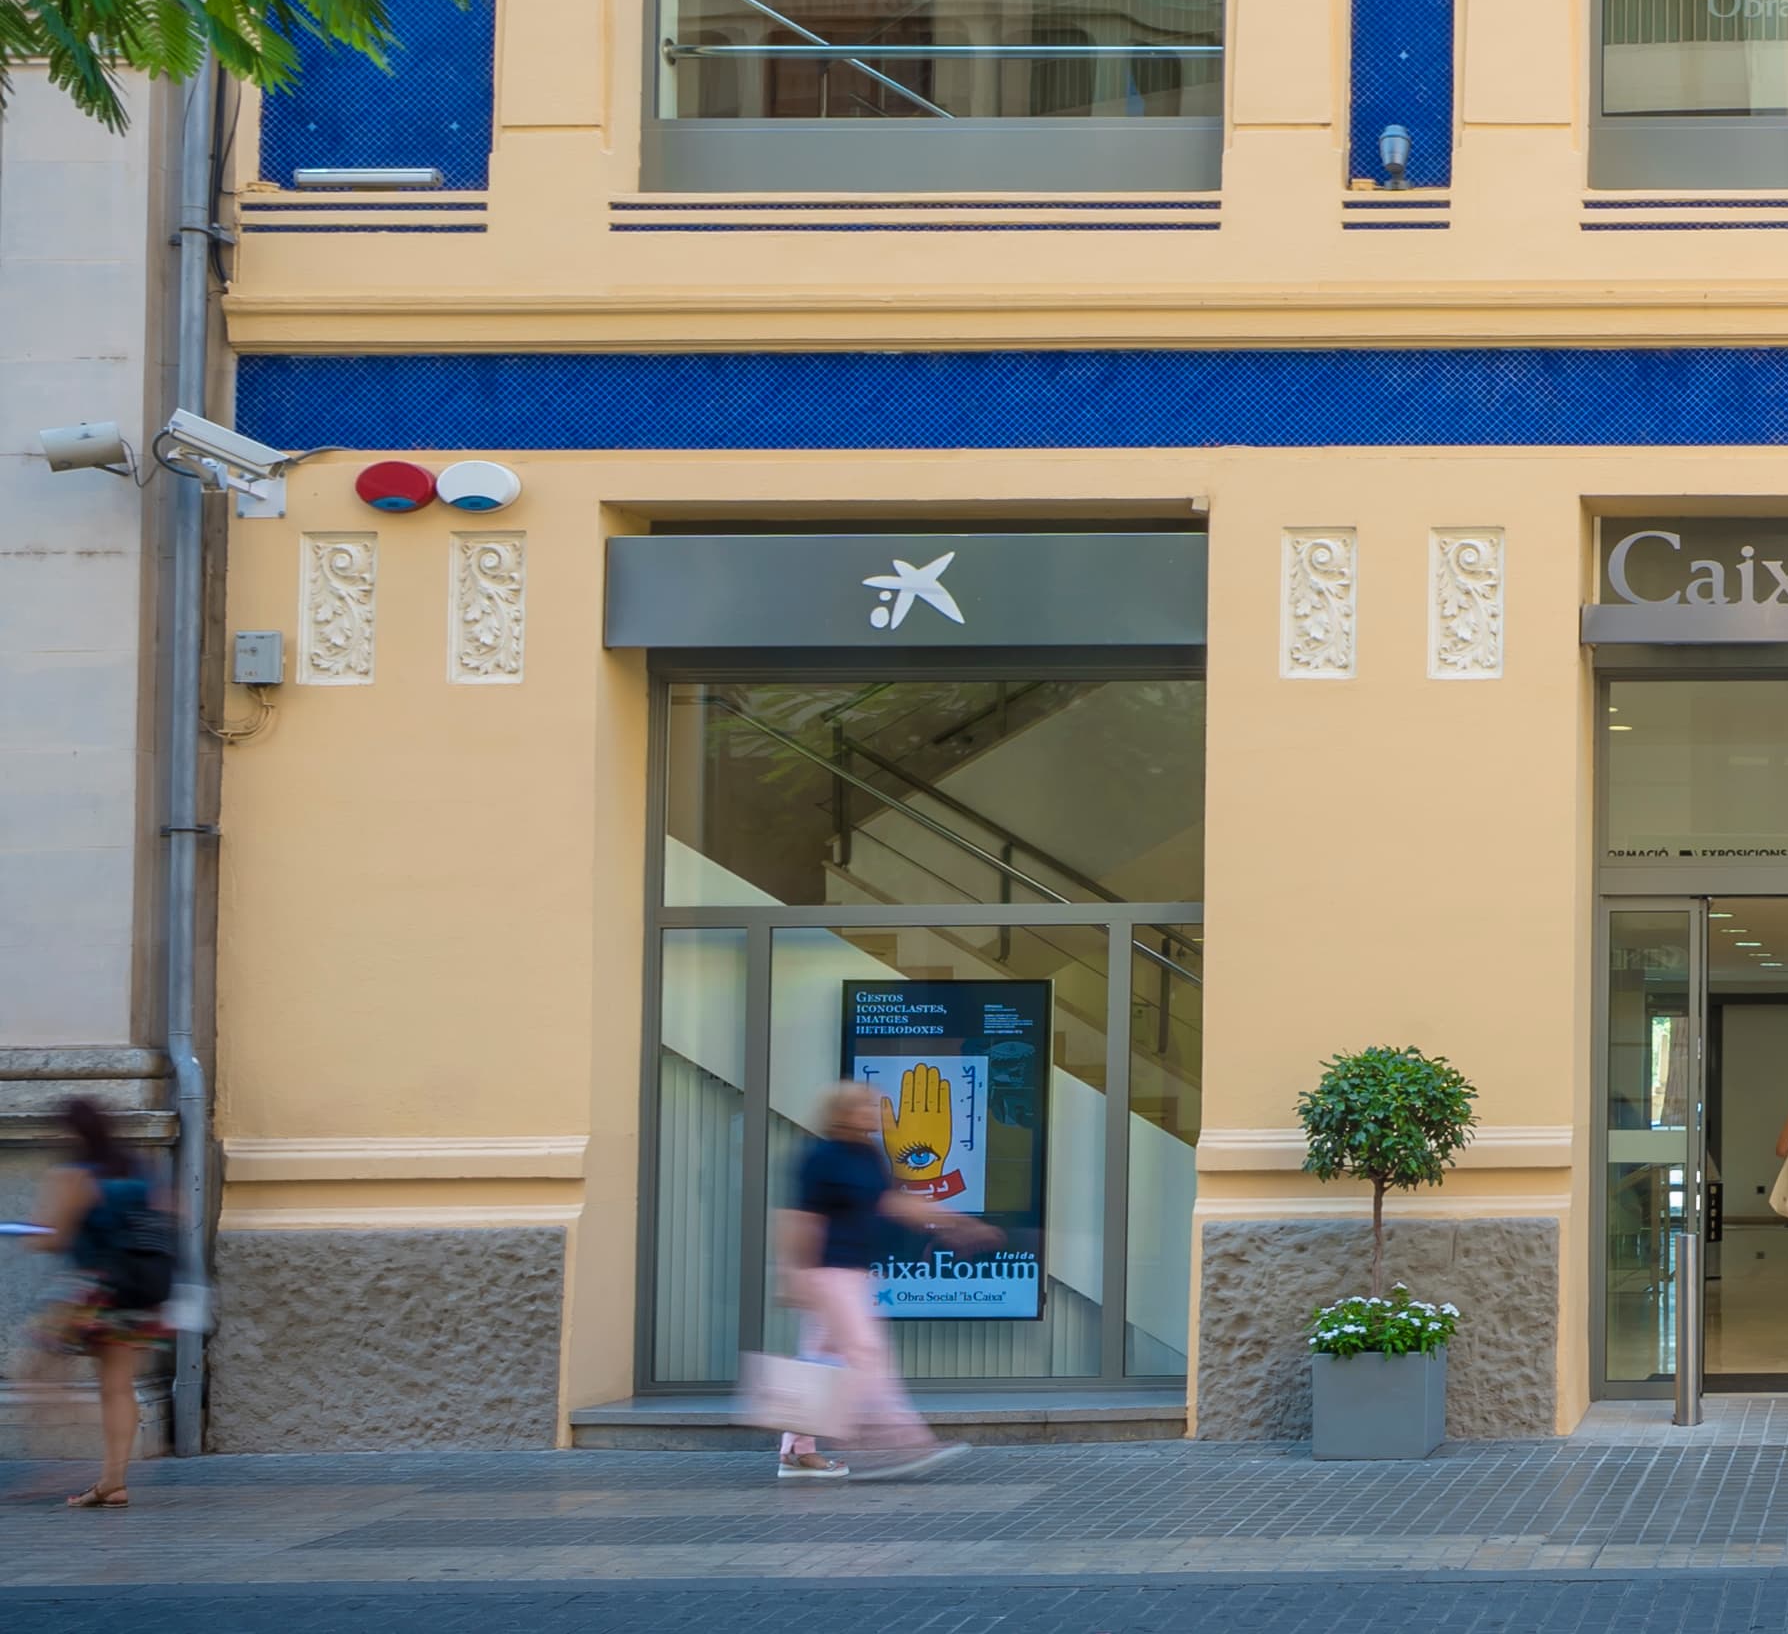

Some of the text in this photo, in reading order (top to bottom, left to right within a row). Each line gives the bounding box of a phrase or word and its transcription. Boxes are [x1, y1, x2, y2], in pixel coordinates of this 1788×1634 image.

[856, 1004, 948, 1015] ICONOCLASTES,
[856, 1015, 909, 1024] IMATGES
[856, 1025, 945, 1035] HETERODOXES
[995, 1251, 1036, 1260] Lleida
[868, 1250, 1039, 1280] aixaForum
[896, 1291, 925, 1302] Obra
[926, 1291, 958, 1302] Social
[973, 1290, 1007, 1302] Caixa"
